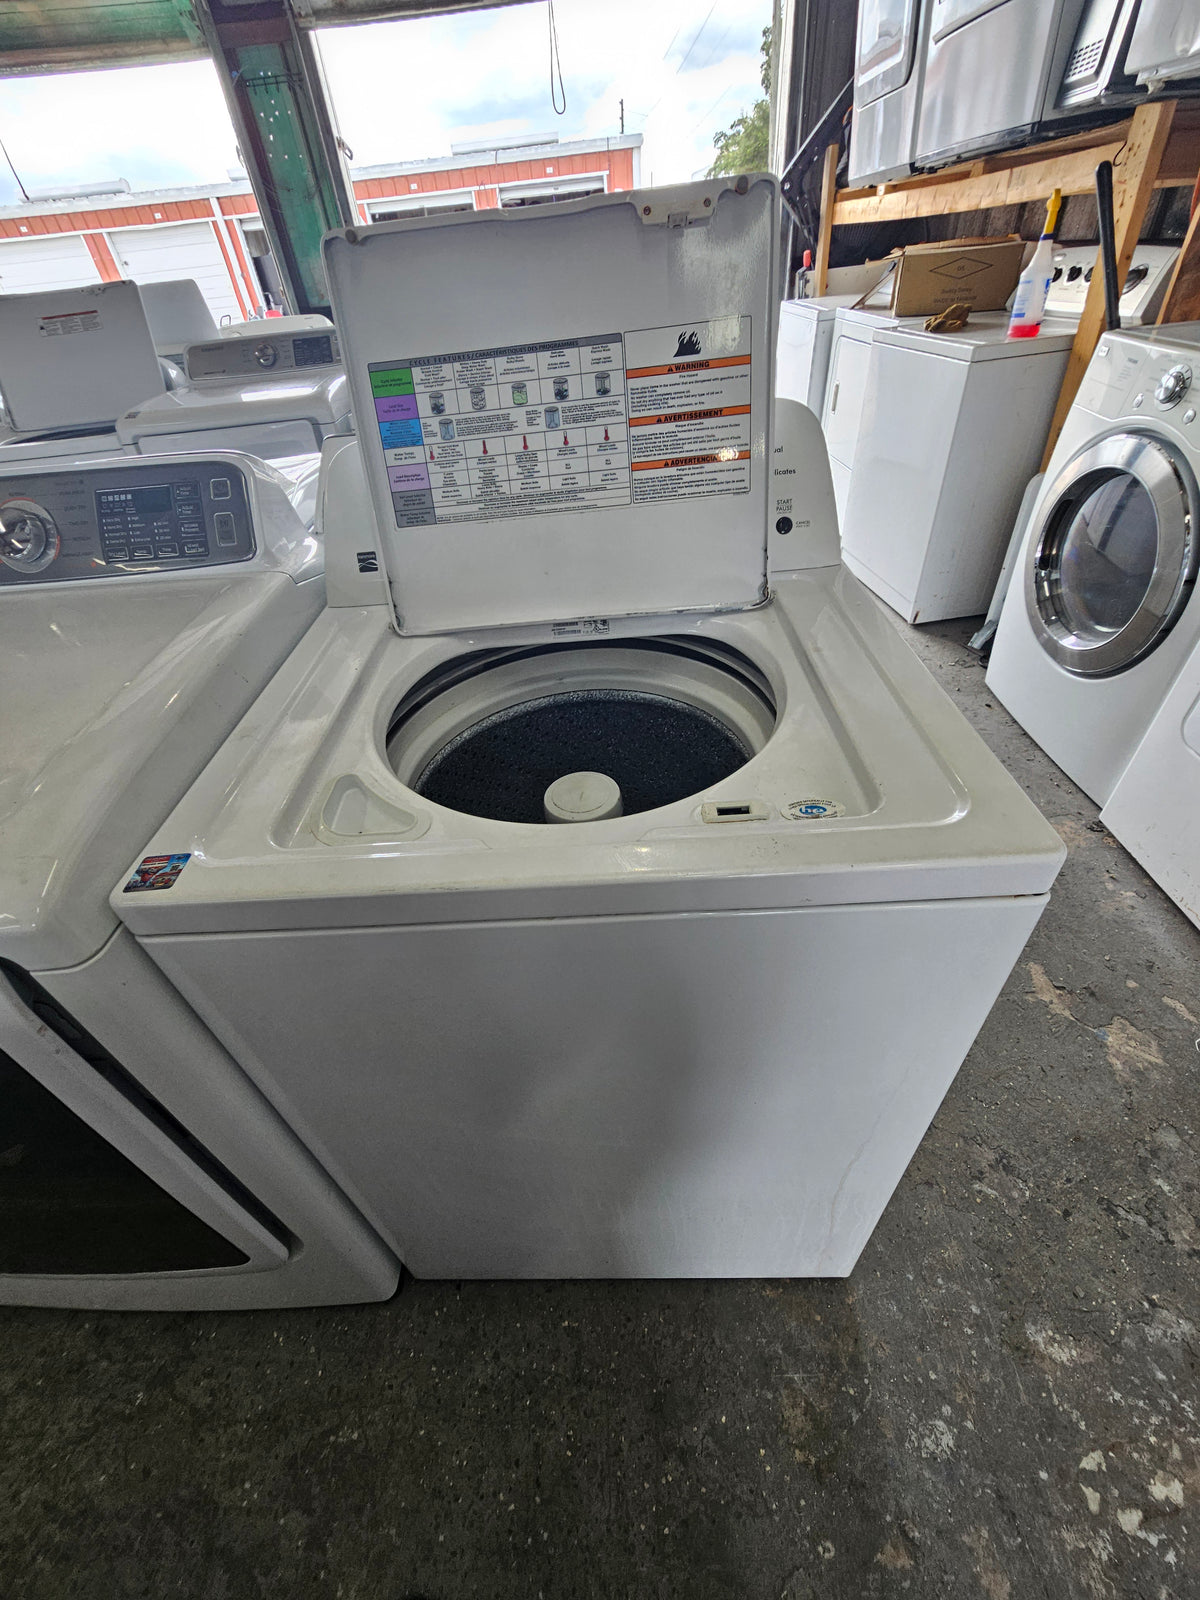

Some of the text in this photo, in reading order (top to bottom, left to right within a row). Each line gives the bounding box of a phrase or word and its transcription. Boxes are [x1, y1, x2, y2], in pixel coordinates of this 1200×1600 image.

[674, 361, 710, 371] WARNING
[664, 409, 723, 422] AVERTISSEMENT
[670, 455, 718, 466] ADVERTENCIA
